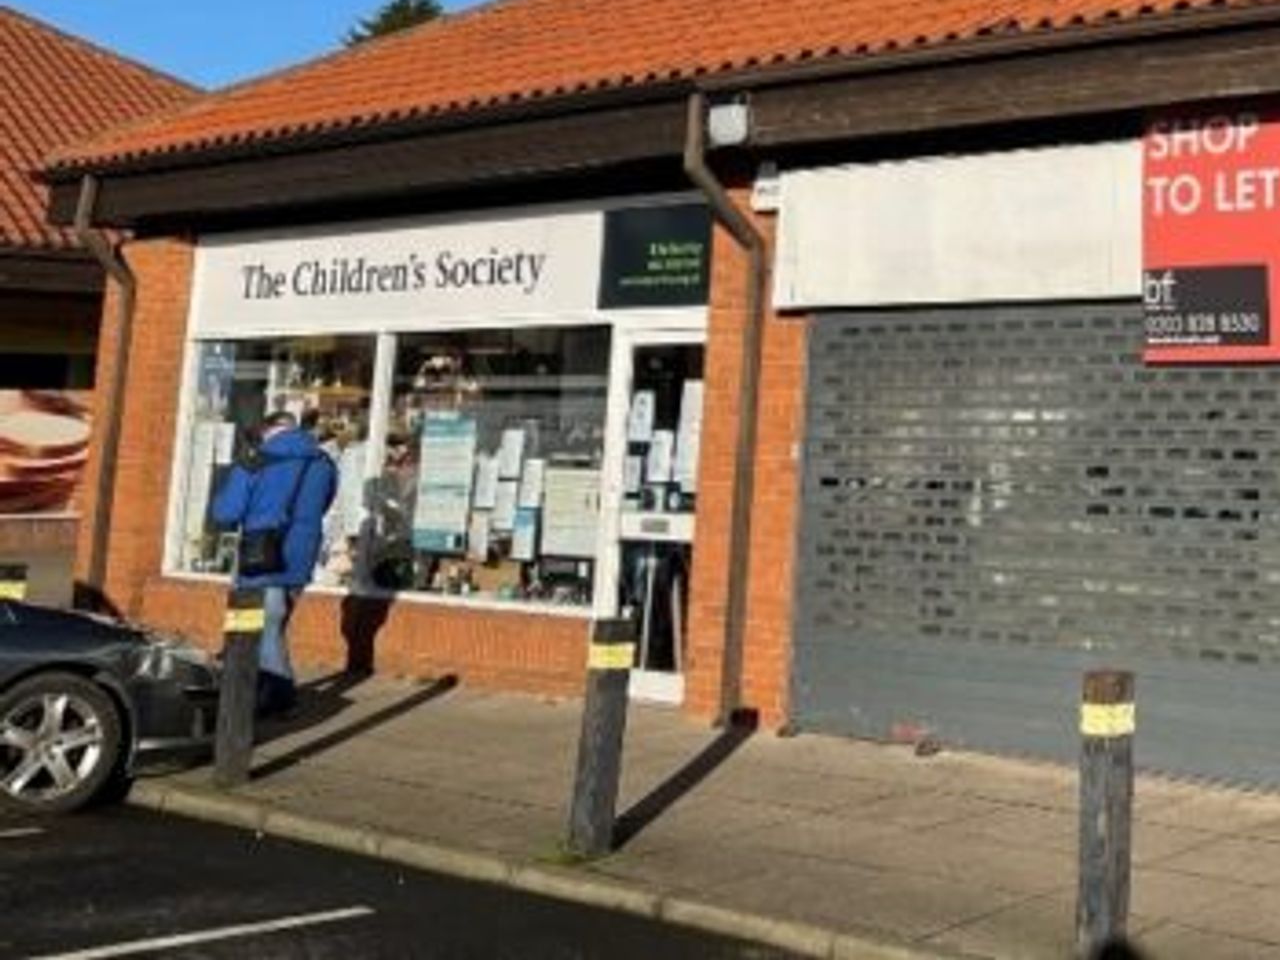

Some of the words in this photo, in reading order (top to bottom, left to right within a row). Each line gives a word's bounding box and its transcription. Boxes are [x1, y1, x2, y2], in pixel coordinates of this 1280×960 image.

[1149, 114, 1259, 159] SHOP
[1147, 172, 1202, 216] TO
[1213, 167, 1280, 212] LET
[242, 264, 286, 300] The
[291, 252, 427, 296] Children's
[434, 248, 546, 294] Society
